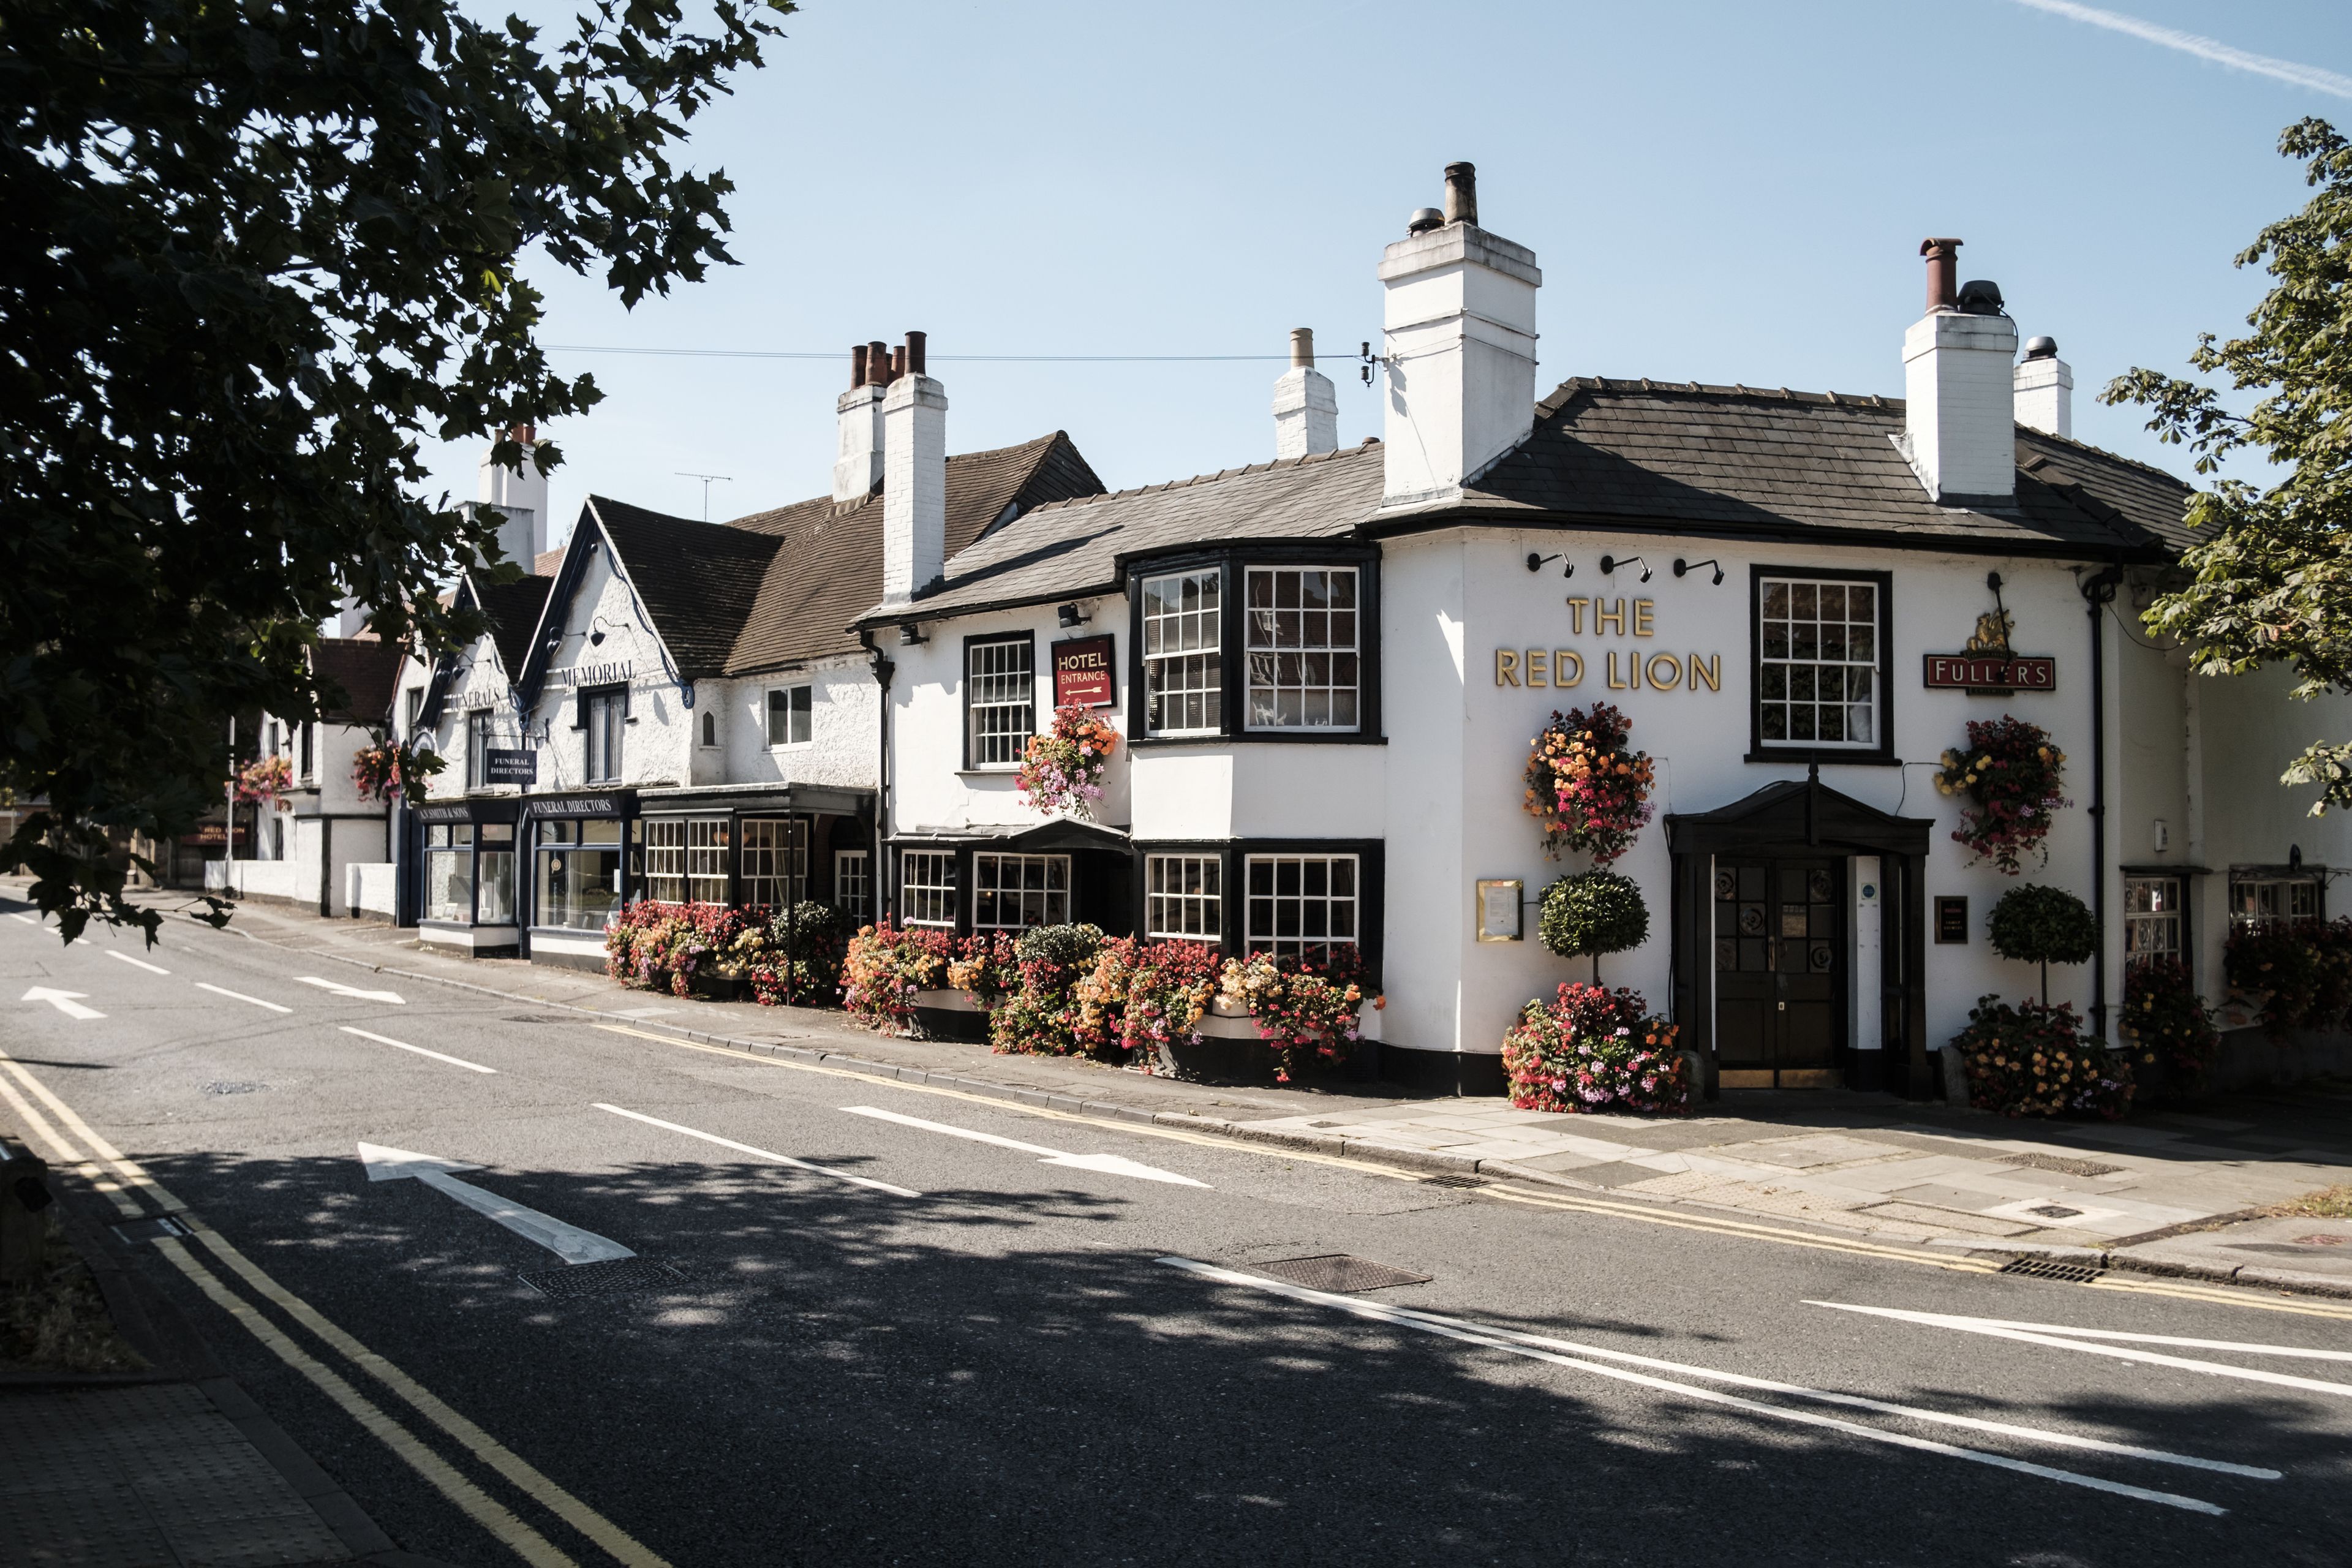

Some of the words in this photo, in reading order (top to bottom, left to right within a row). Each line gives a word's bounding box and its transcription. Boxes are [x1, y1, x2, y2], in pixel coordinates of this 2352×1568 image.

[1567, 598, 1653, 636] THE
[1058, 652, 1107, 671] HOTEL
[1496, 649, 1585, 687] RED
[1607, 652, 1721, 691] LION
[1936, 660, 2046, 685] FULLER'S
[562, 660, 637, 687] MEMORIAL
[1061, 671, 1106, 684] ENTRANCE
[450, 688, 500, 710] FUNERALS
[453, 807, 468, 818] SONS
[533, 801, 567, 813] FUNERAL
[567, 799, 611, 812] DIRECTORS
